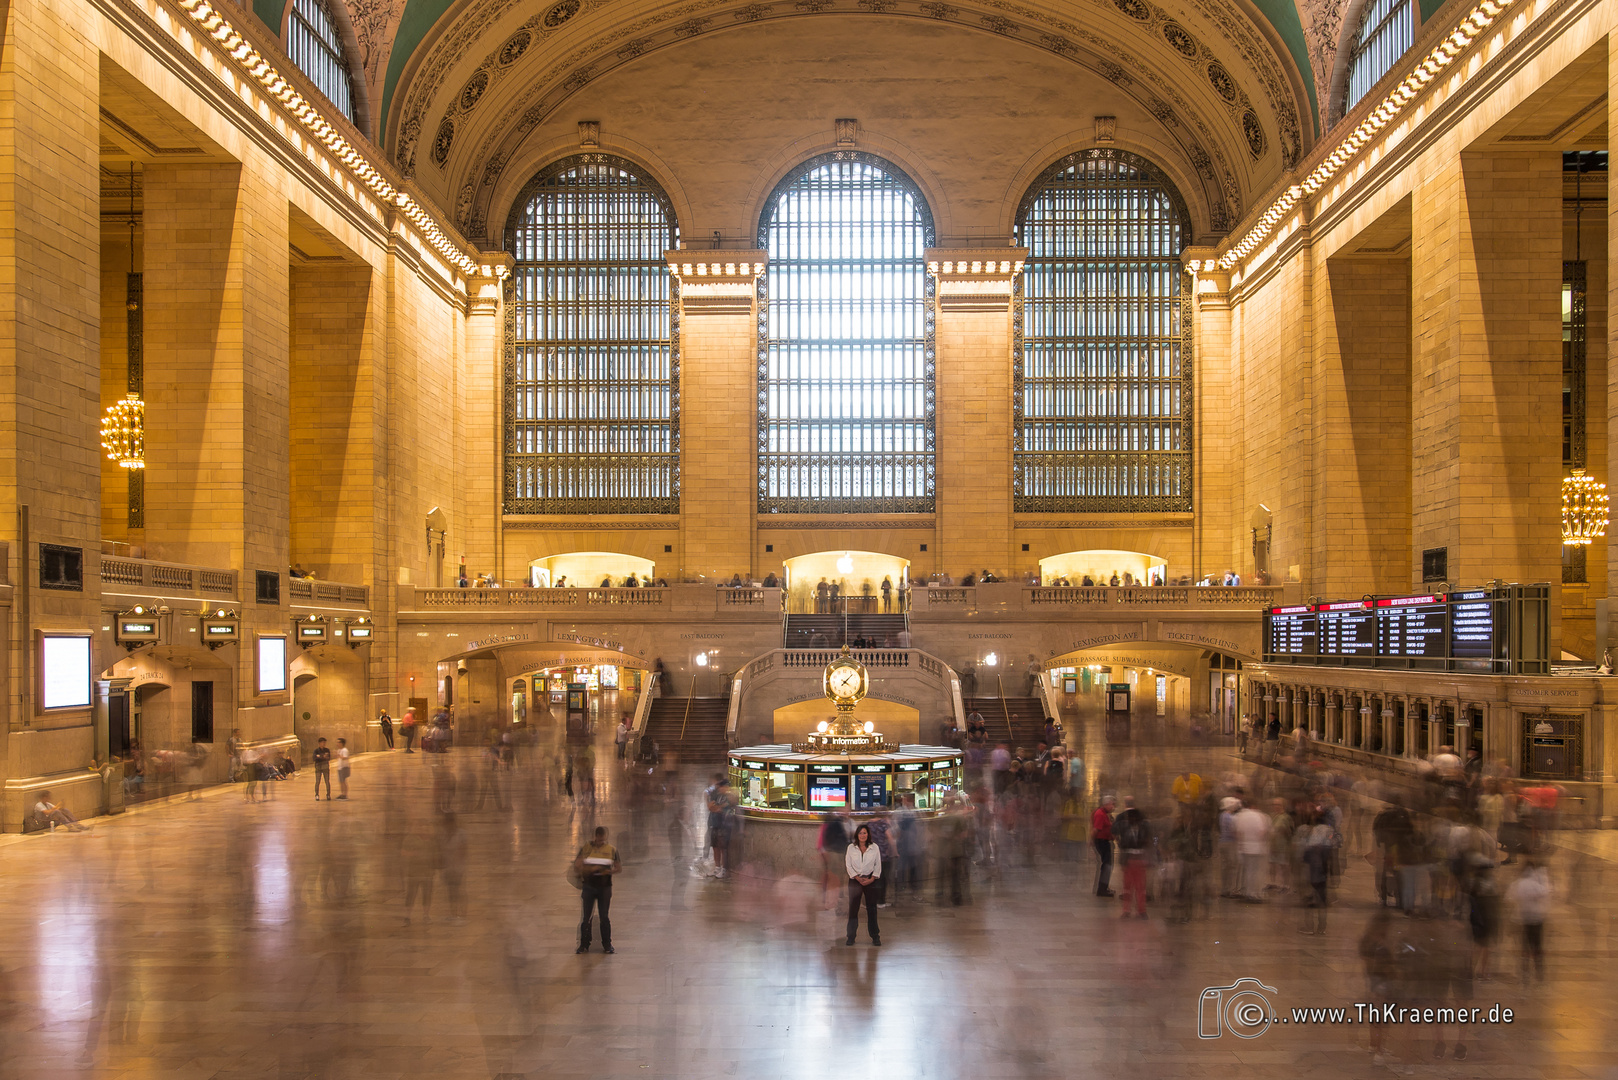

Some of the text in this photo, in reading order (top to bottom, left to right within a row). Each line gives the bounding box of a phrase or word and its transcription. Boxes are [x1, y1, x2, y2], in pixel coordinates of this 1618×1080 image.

[469, 637, 500, 648] TRACKS
[557, 634, 604, 645] LEXINGTON
[1072, 634, 1120, 648] LEXINGTON
[1198, 636, 1240, 650] MACHINES
[786, 694, 807, 702] TRACKS
[884, 694, 915, 705] CONCOURSE
[832, 736, 870, 744] Information
